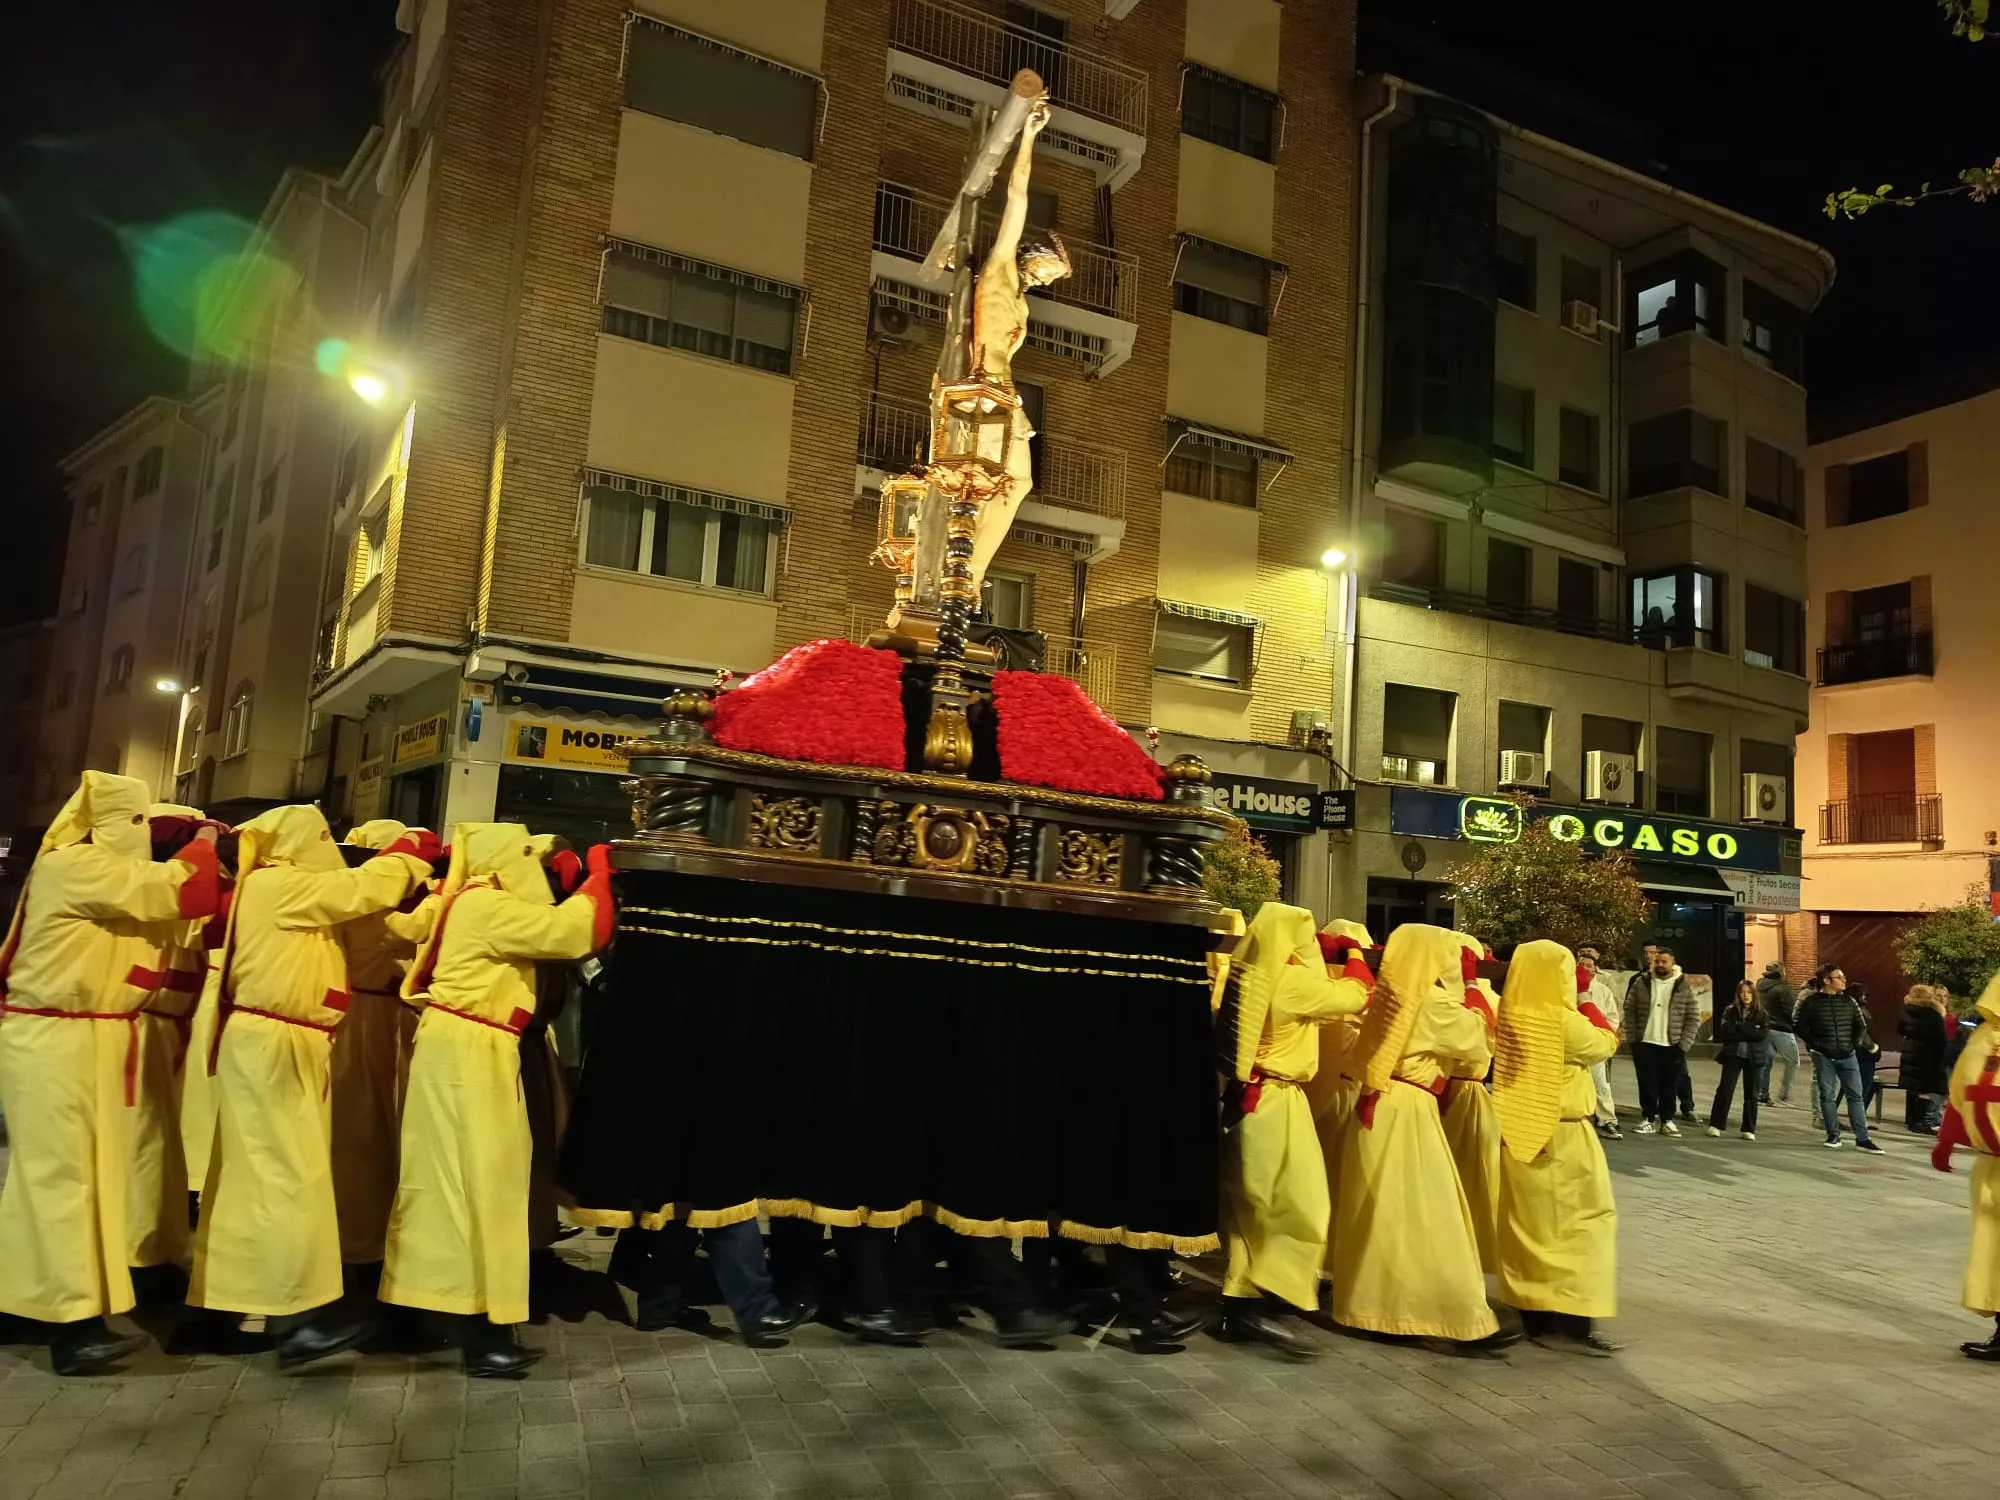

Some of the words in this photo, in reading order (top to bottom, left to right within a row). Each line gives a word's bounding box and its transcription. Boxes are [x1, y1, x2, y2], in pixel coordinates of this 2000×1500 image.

[1232, 785, 1311, 817] House
[1323, 796, 1338, 805] The
[1323, 804, 1346, 813] Phone
[1323, 814, 1346, 822] House
[1549, 814, 1738, 860] OCASO
[1756, 877, 1777, 888] Frutas
